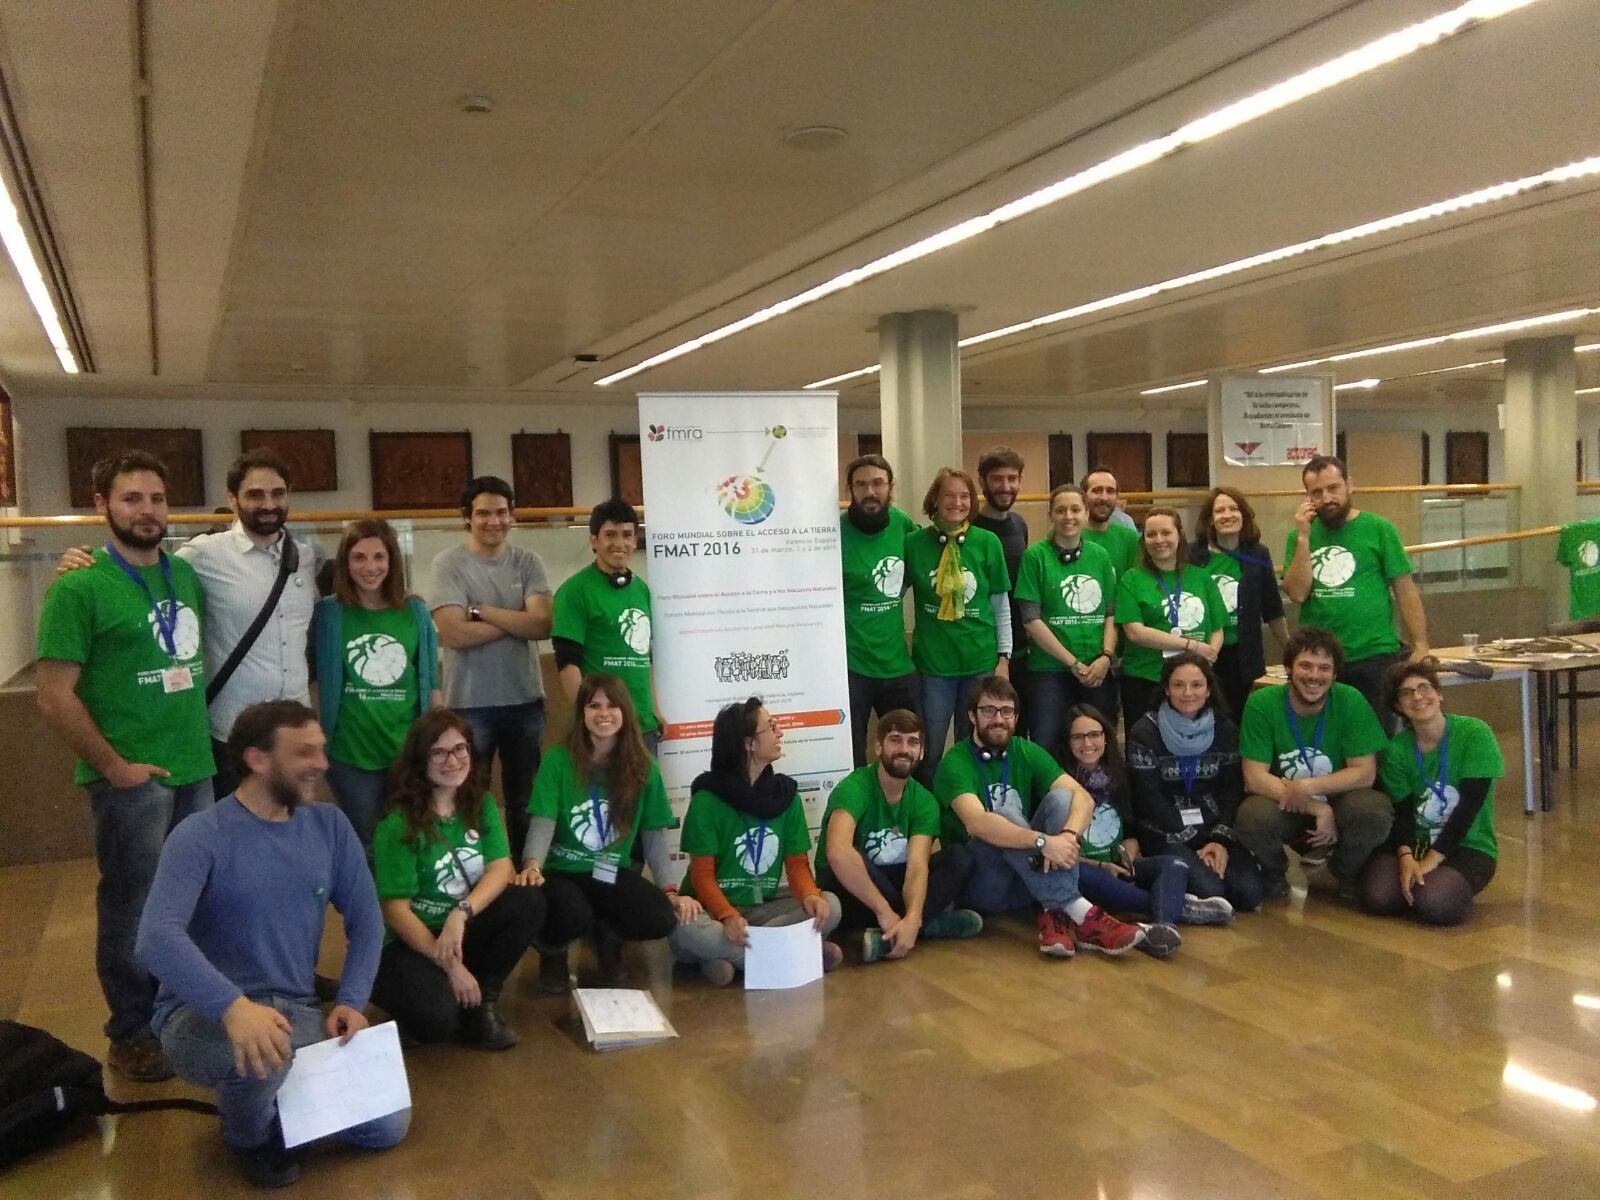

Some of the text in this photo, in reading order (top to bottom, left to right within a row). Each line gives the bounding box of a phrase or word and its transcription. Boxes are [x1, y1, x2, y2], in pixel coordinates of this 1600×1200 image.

[667, 426, 703, 440] fmra
[652, 526, 837, 541] FORO MUNDIAL SOBRE EL ACCESO A LA TIERRA
[653, 541, 741, 559] FMAT 2016
